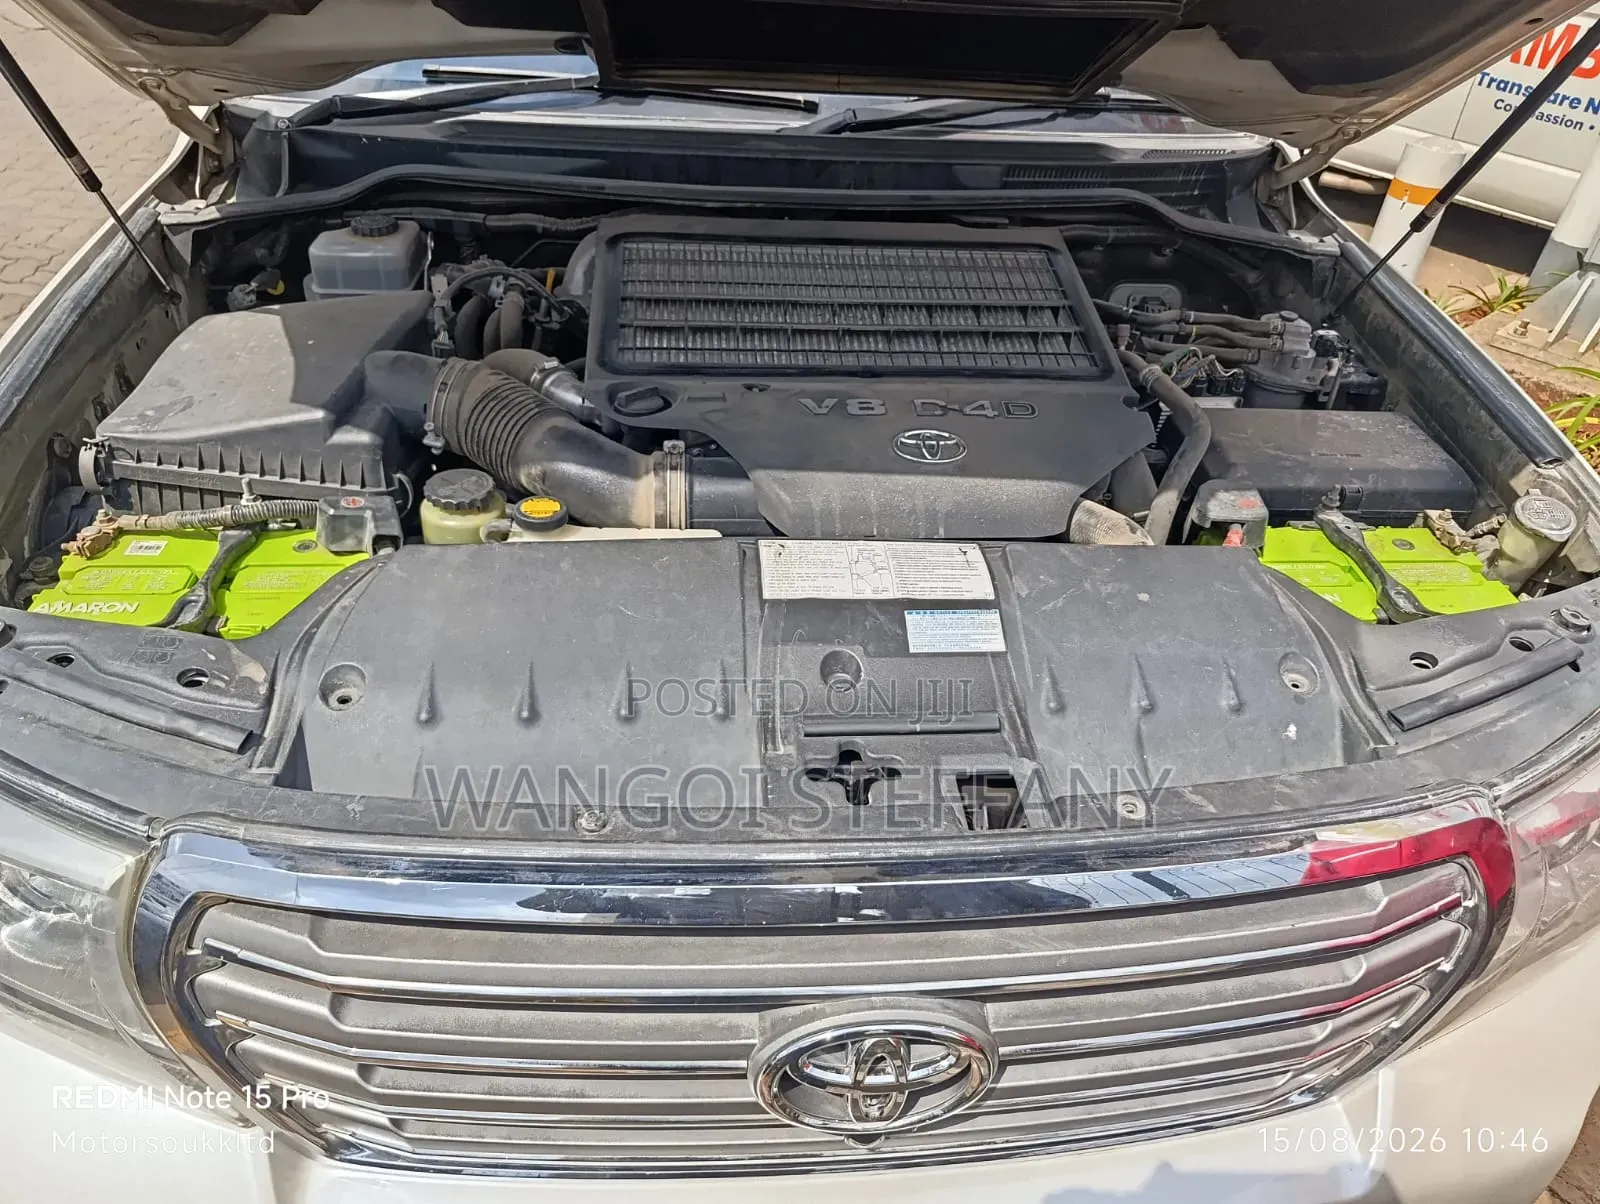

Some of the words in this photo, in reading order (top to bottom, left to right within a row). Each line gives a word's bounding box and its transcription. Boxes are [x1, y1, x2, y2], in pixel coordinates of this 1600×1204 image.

[1477, 71, 1582, 110] Transare
[1494, 99, 1584, 131] Coassion
[799, 398, 888, 417] V8
[913, 399, 1039, 419] D-4D
[33, 600, 140, 615] AMARON
